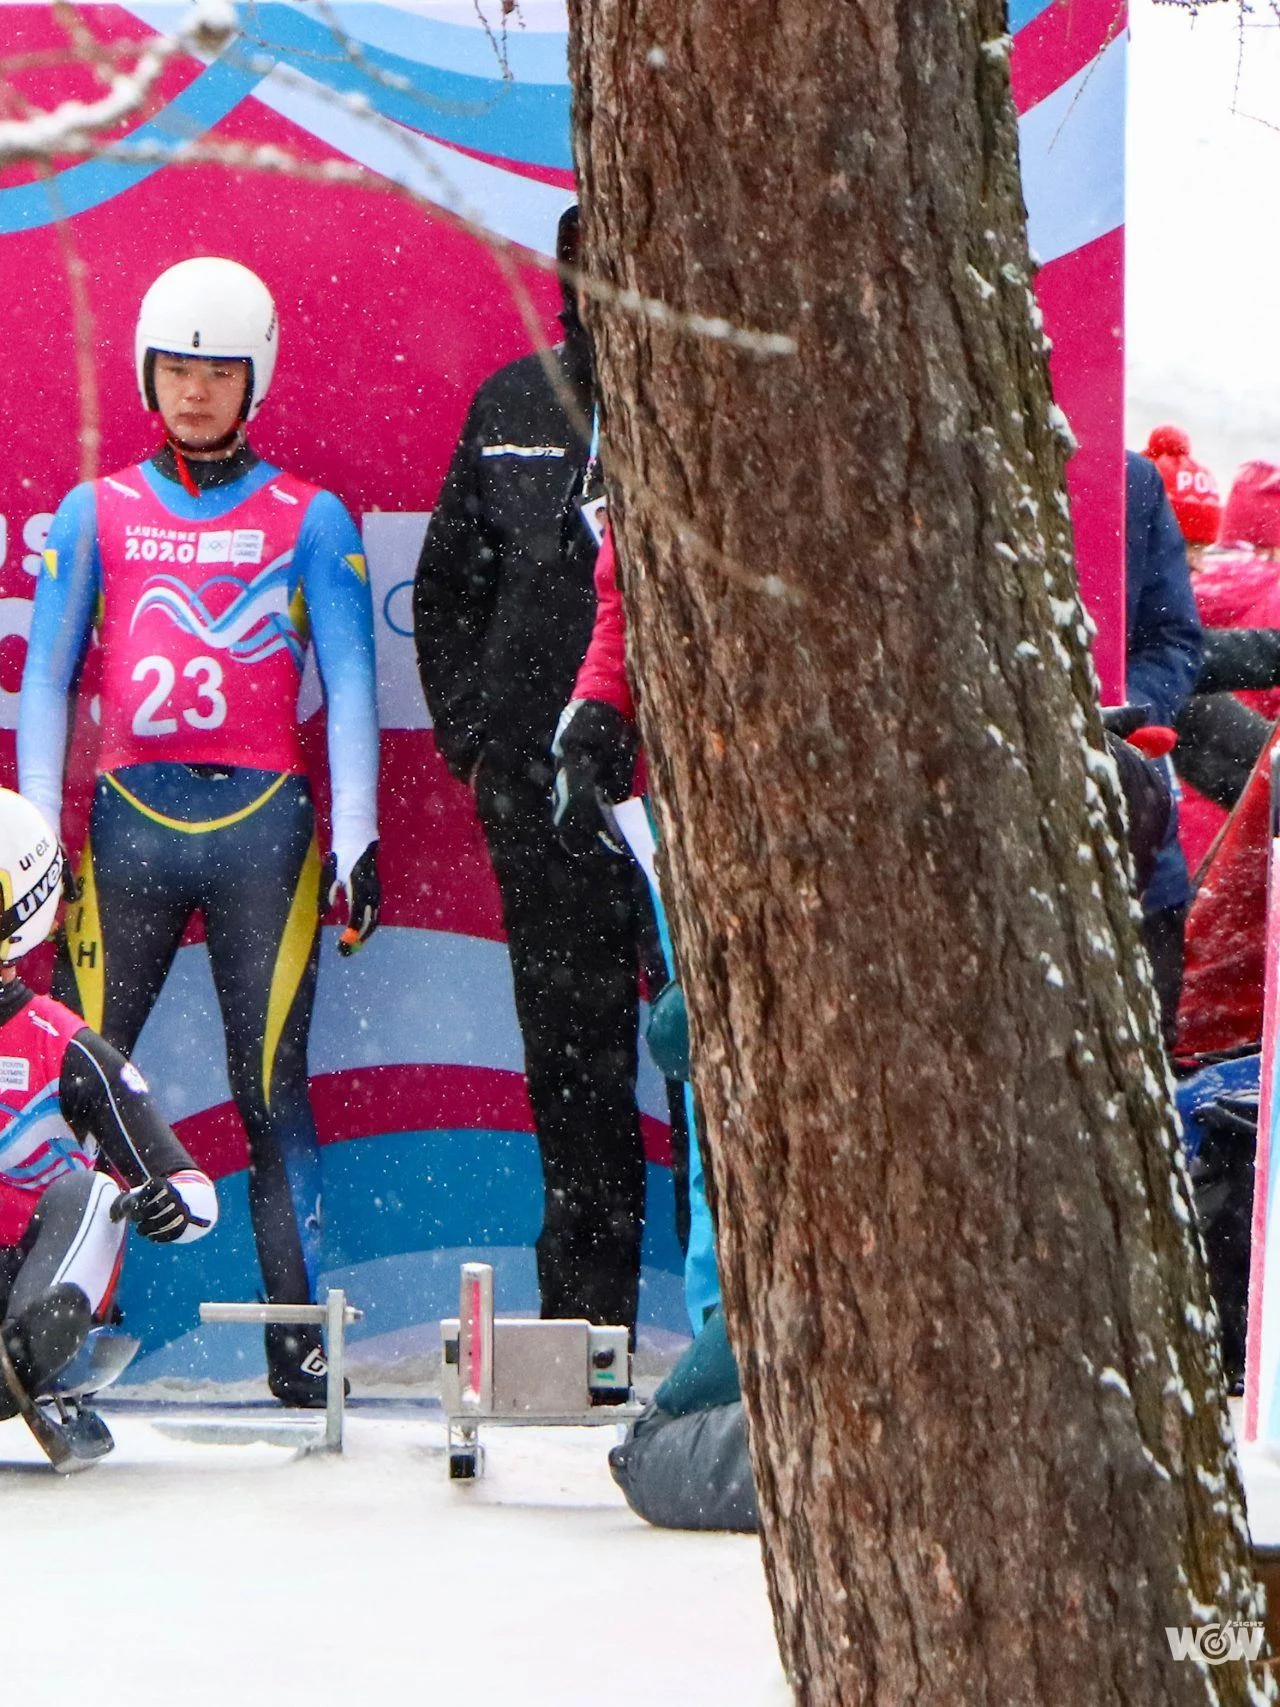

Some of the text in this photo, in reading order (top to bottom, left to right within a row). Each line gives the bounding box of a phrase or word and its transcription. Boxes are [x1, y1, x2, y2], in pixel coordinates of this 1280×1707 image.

[125, 525, 197, 542] LAUSANNE
[125, 538, 195, 563] 2020
[131, 655, 228, 736] 23
